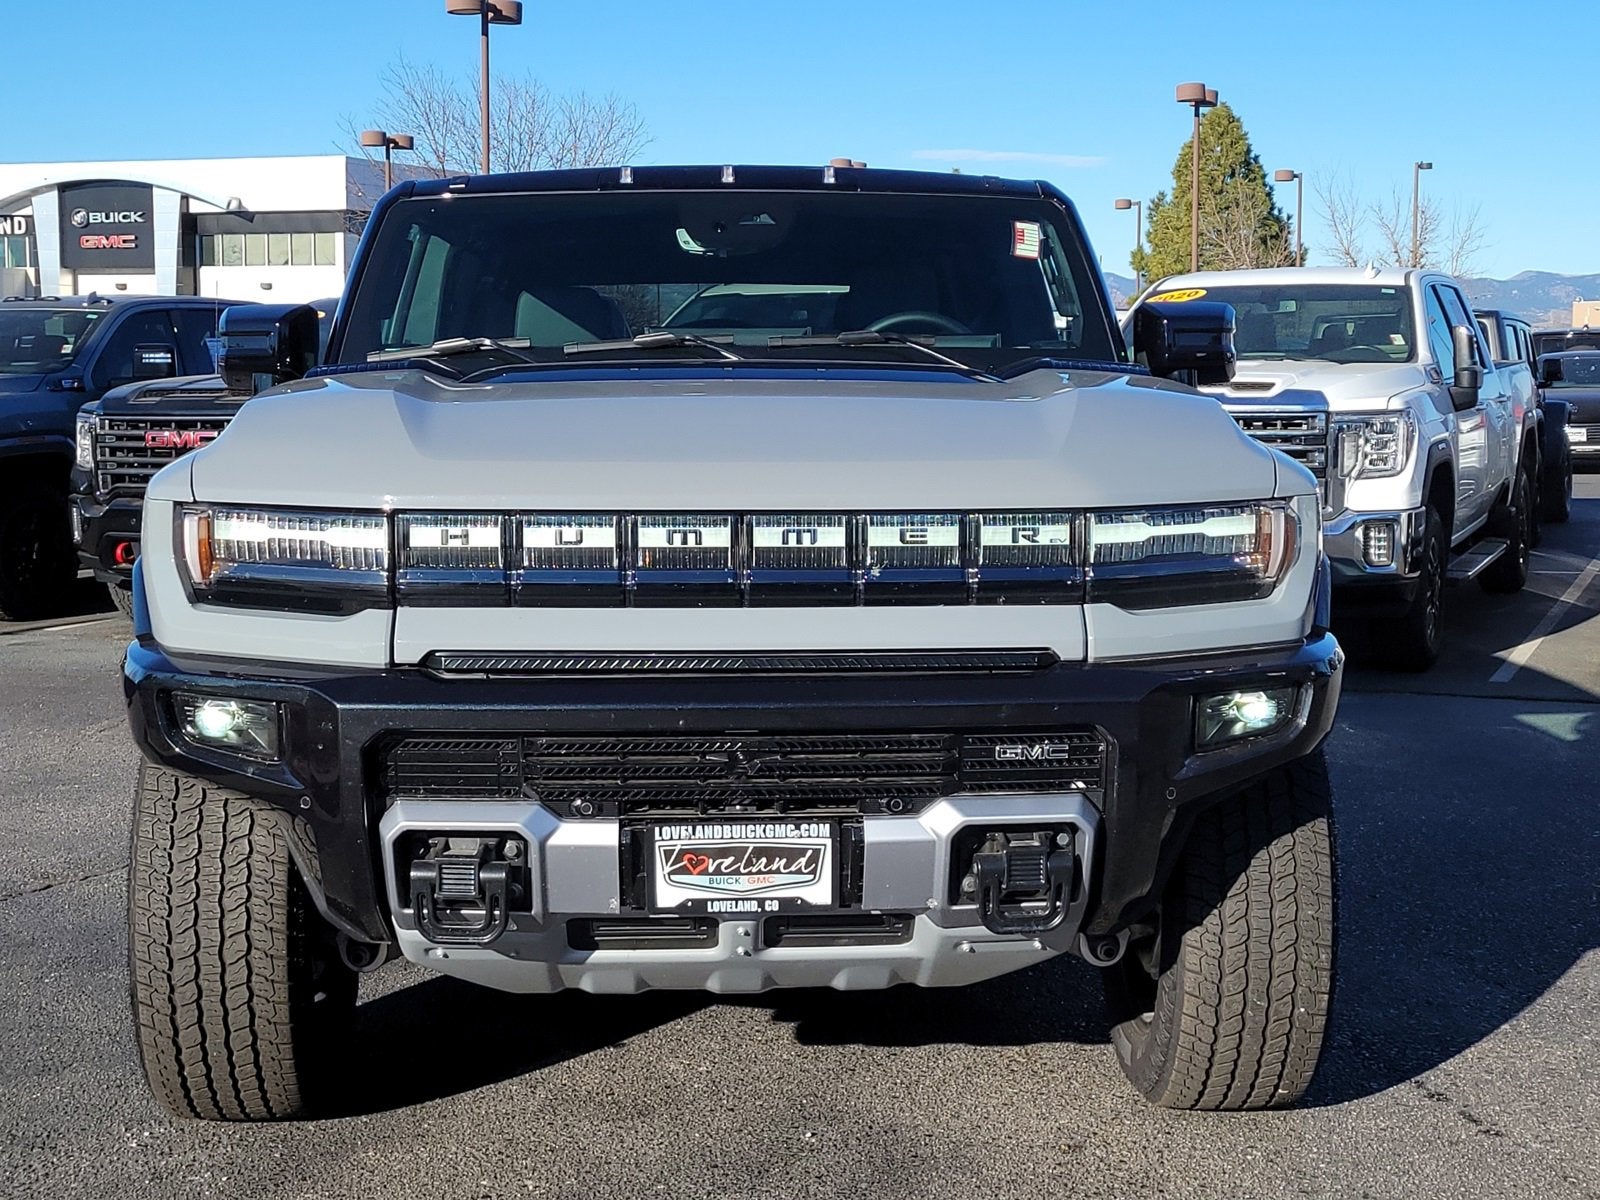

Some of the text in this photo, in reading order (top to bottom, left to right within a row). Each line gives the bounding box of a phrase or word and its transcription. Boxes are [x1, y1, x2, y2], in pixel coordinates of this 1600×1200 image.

[89, 211, 145, 223] BUICK
[80, 235, 136, 248] GMC
[145, 431, 218, 448] GMC
[441, 527, 1040, 546] HUMMER
[995, 744, 1069, 760] GMC
[654, 824, 830, 840] LOVELANDBUICKGMC.COM
[709, 876, 776, 885] BUICK GMC
[707, 900, 779, 912] LOVELAND, CO
